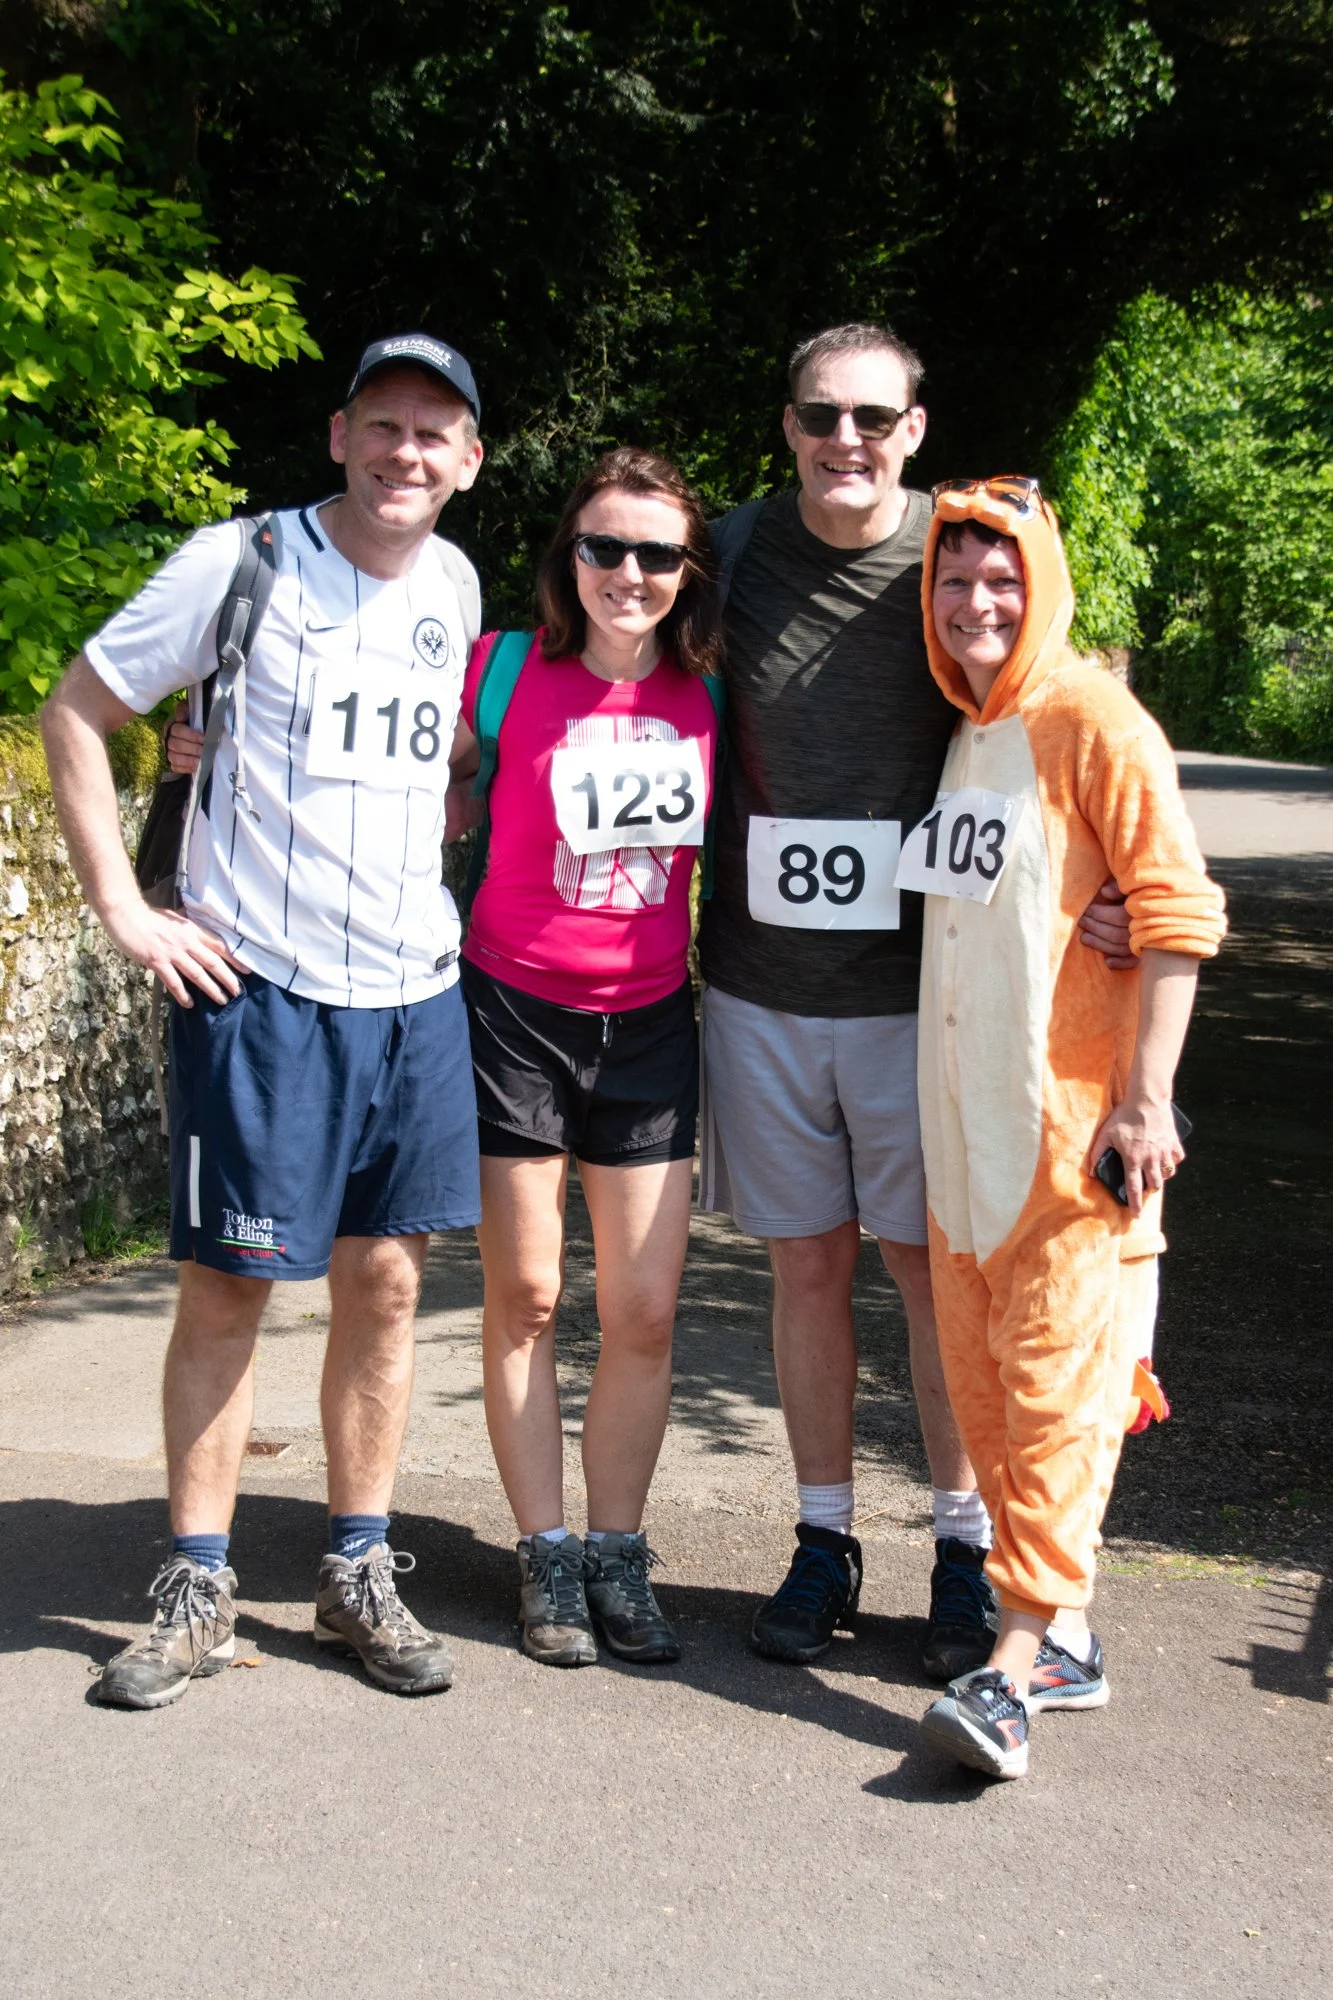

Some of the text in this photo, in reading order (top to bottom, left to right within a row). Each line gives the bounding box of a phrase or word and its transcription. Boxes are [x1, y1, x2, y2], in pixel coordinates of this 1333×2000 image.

[383, 339, 452, 362] BREMONT
[332, 692, 441, 763] 118
[571, 767, 695, 831] 123
[778, 844, 866, 905] 89
[921, 810, 1006, 881] 103
[222, 1208, 273, 1230] Totton
[223, 1224, 273, 1246] & Eling
